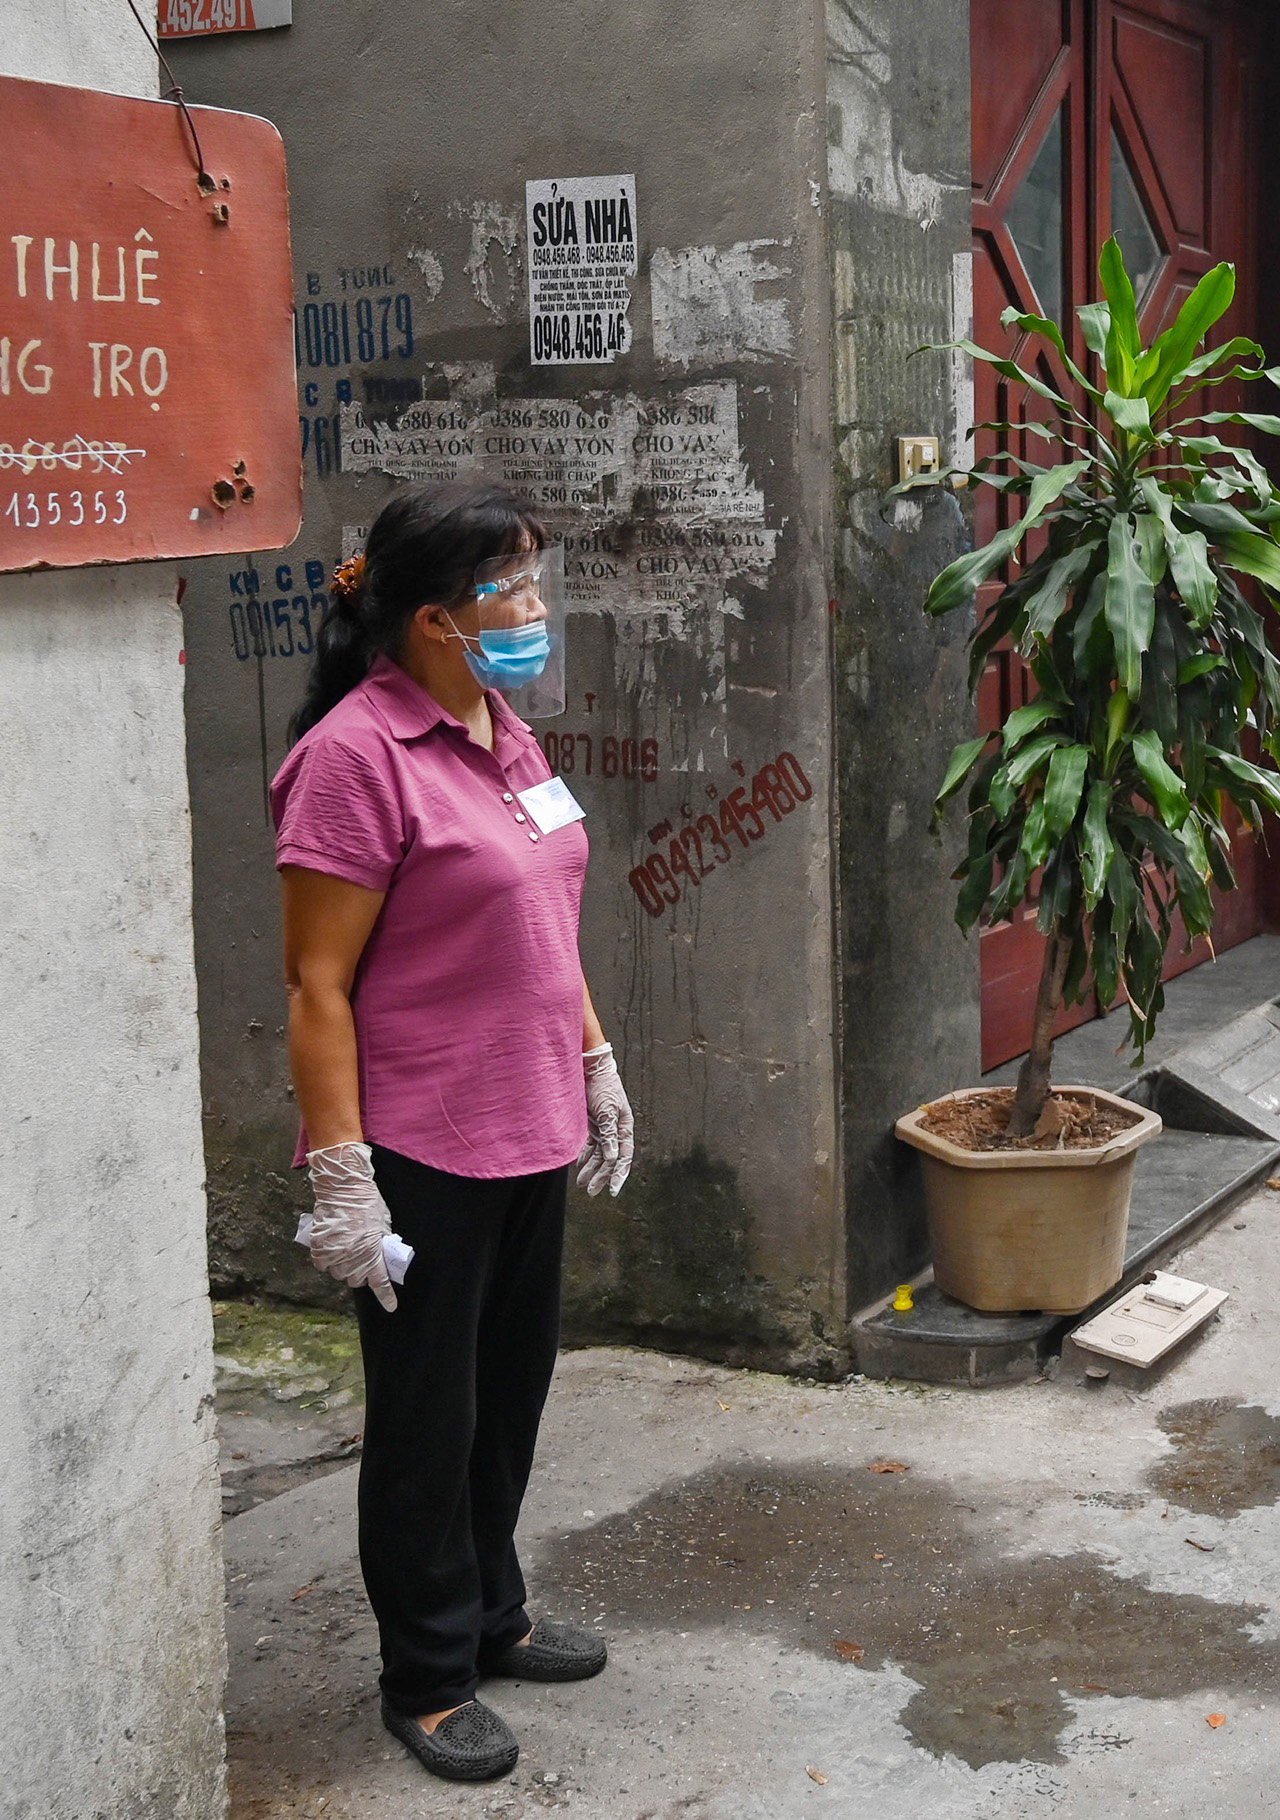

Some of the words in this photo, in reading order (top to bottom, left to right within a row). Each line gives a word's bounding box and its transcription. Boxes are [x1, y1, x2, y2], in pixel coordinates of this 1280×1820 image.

[533, 182, 579, 247] SỬA
[584, 188, 633, 244] NHÀ
[11, 227, 161, 306] THUÊ
[533, 246, 581, 266] 0948.456.468
[586, 244, 635, 264] 0948.456.468
[615, 300, 625, 310] A-Z
[88, 342, 168, 412] TRỌ
[305, 382, 319, 408] C
[538, 409, 571, 429] 580
[485, 436, 525, 455] CHO
[531, 437, 570, 455] VAY
[574, 432, 615, 456] VỐN
[632, 435, 674, 453] CHO
[275, 564, 293, 592] C
[636, 556, 679, 575] CHO
[682, 556, 726, 574] VAY
[628, 751, 813, 919] 0942345480
